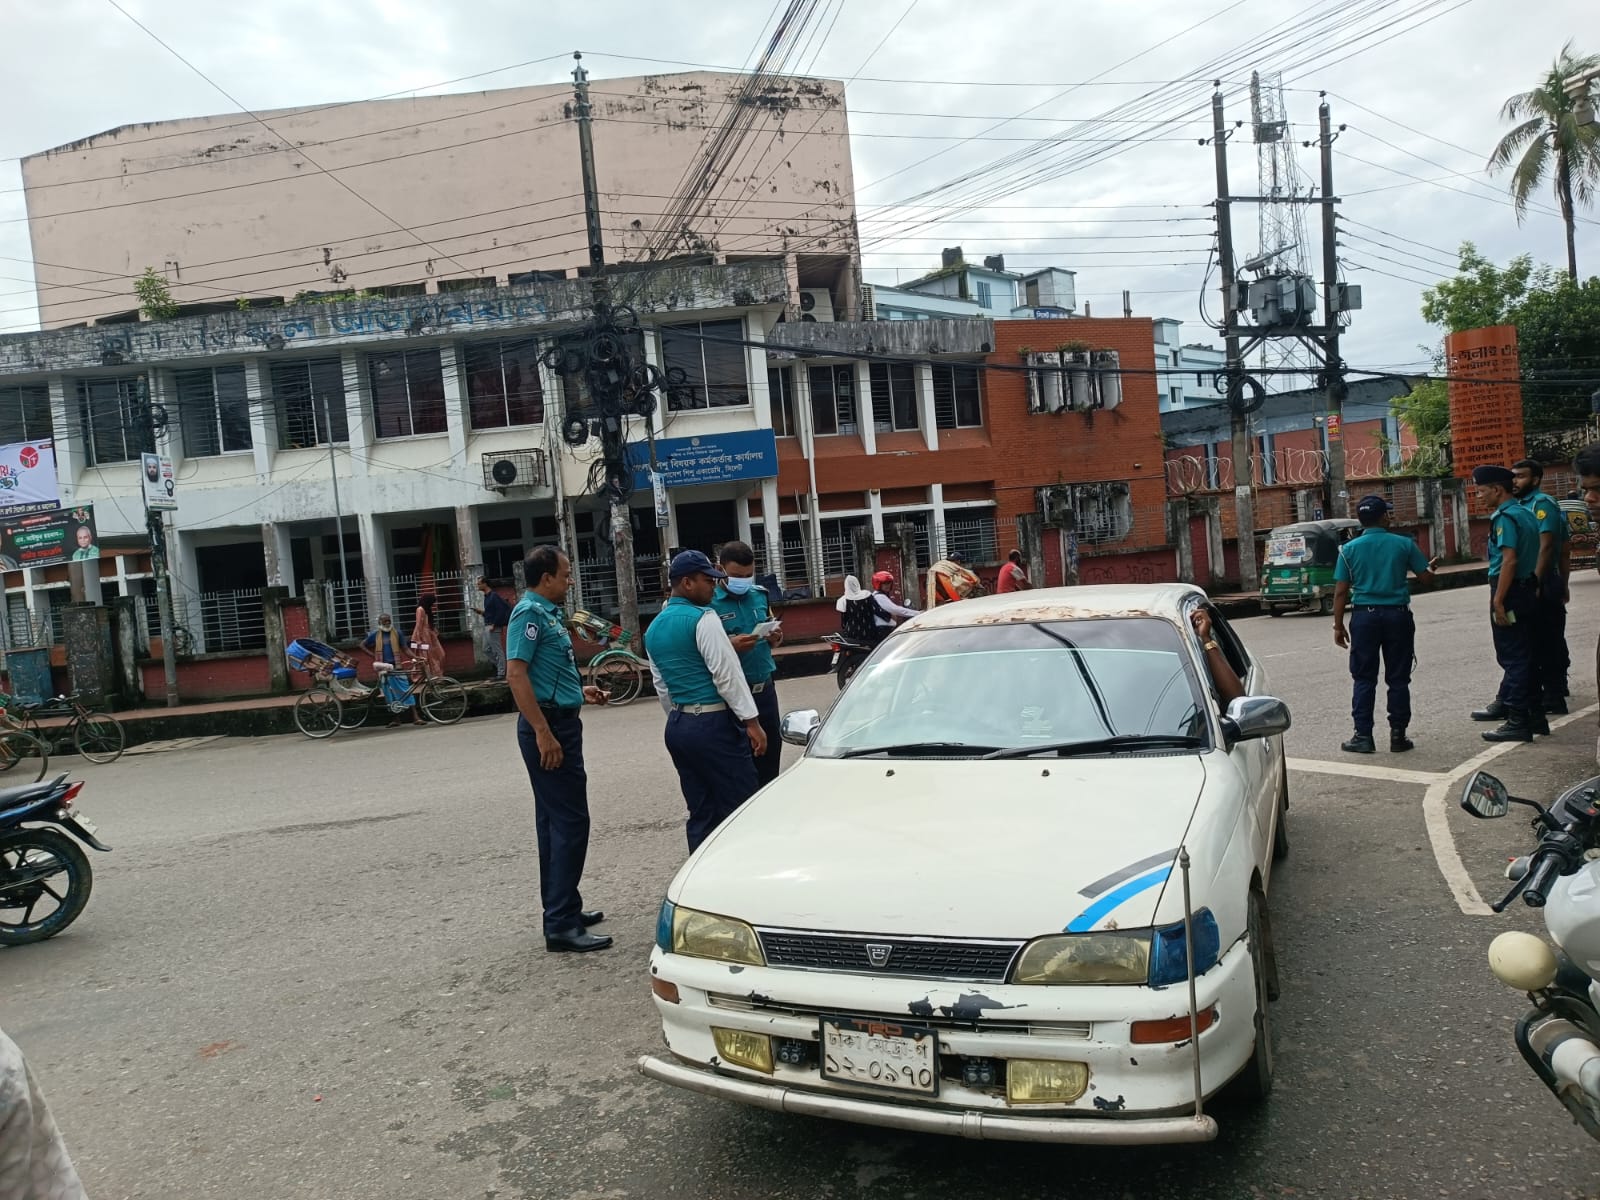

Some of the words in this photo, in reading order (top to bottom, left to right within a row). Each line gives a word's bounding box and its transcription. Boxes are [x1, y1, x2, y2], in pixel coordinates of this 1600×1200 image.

[698, 454, 733, 465] কর্মকর্তার
[735, 451, 764, 462] কার্যালয়
[851, 1019, 902, 1039] TRD
[828, 1032, 863, 1050] ঢাকা
